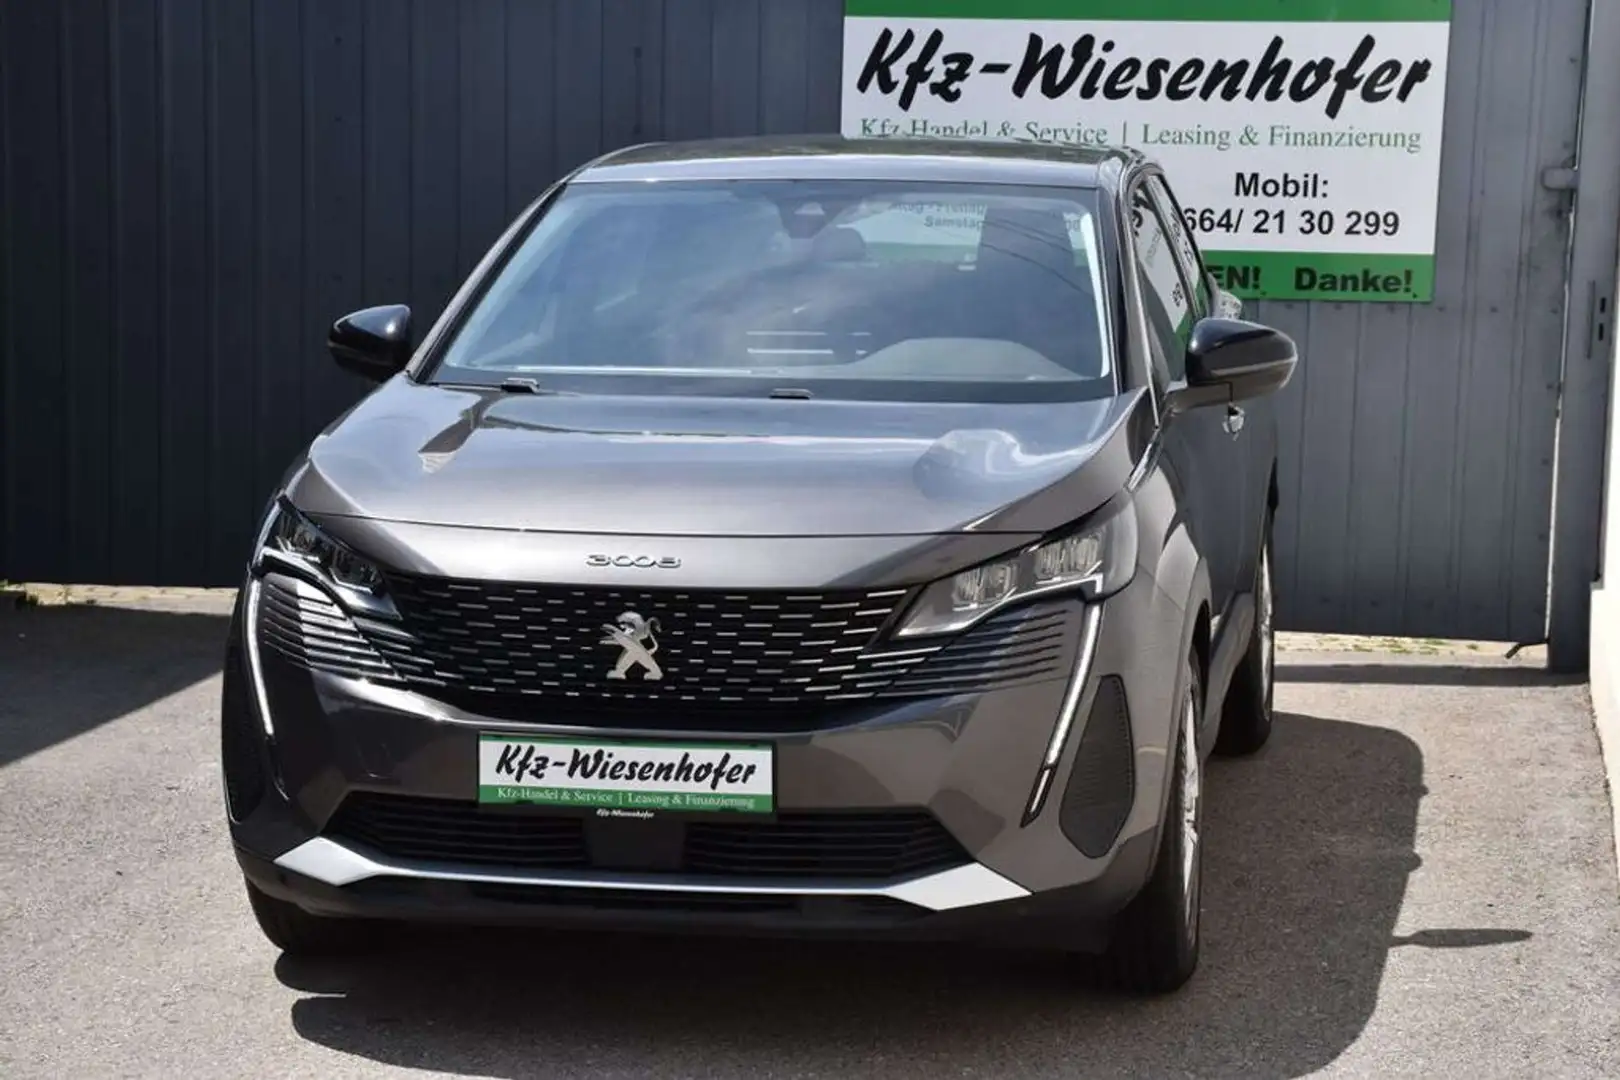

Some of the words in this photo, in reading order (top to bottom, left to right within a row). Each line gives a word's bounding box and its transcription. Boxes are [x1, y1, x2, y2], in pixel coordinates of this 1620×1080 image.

[857, 27, 1432, 119] Kfz-Wiesenhofer
[996, 120, 1016, 138] &
[1026, 121, 1109, 145] Service
[1142, 124, 1230, 150] Leasing
[1238, 125, 1259, 146] &
[1269, 125, 1421, 153] Finanzierung
[1234, 172, 1329, 198] Mobil:
[1253, 209, 1285, 234] 21
[1299, 210, 1333, 235] 30
[1345, 211, 1400, 236] 299
[1294, 267, 1412, 293] Danke!
[586, 555, 682, 569] 3008
[495, 744, 756, 790] Kfz-Wiesenhofer
